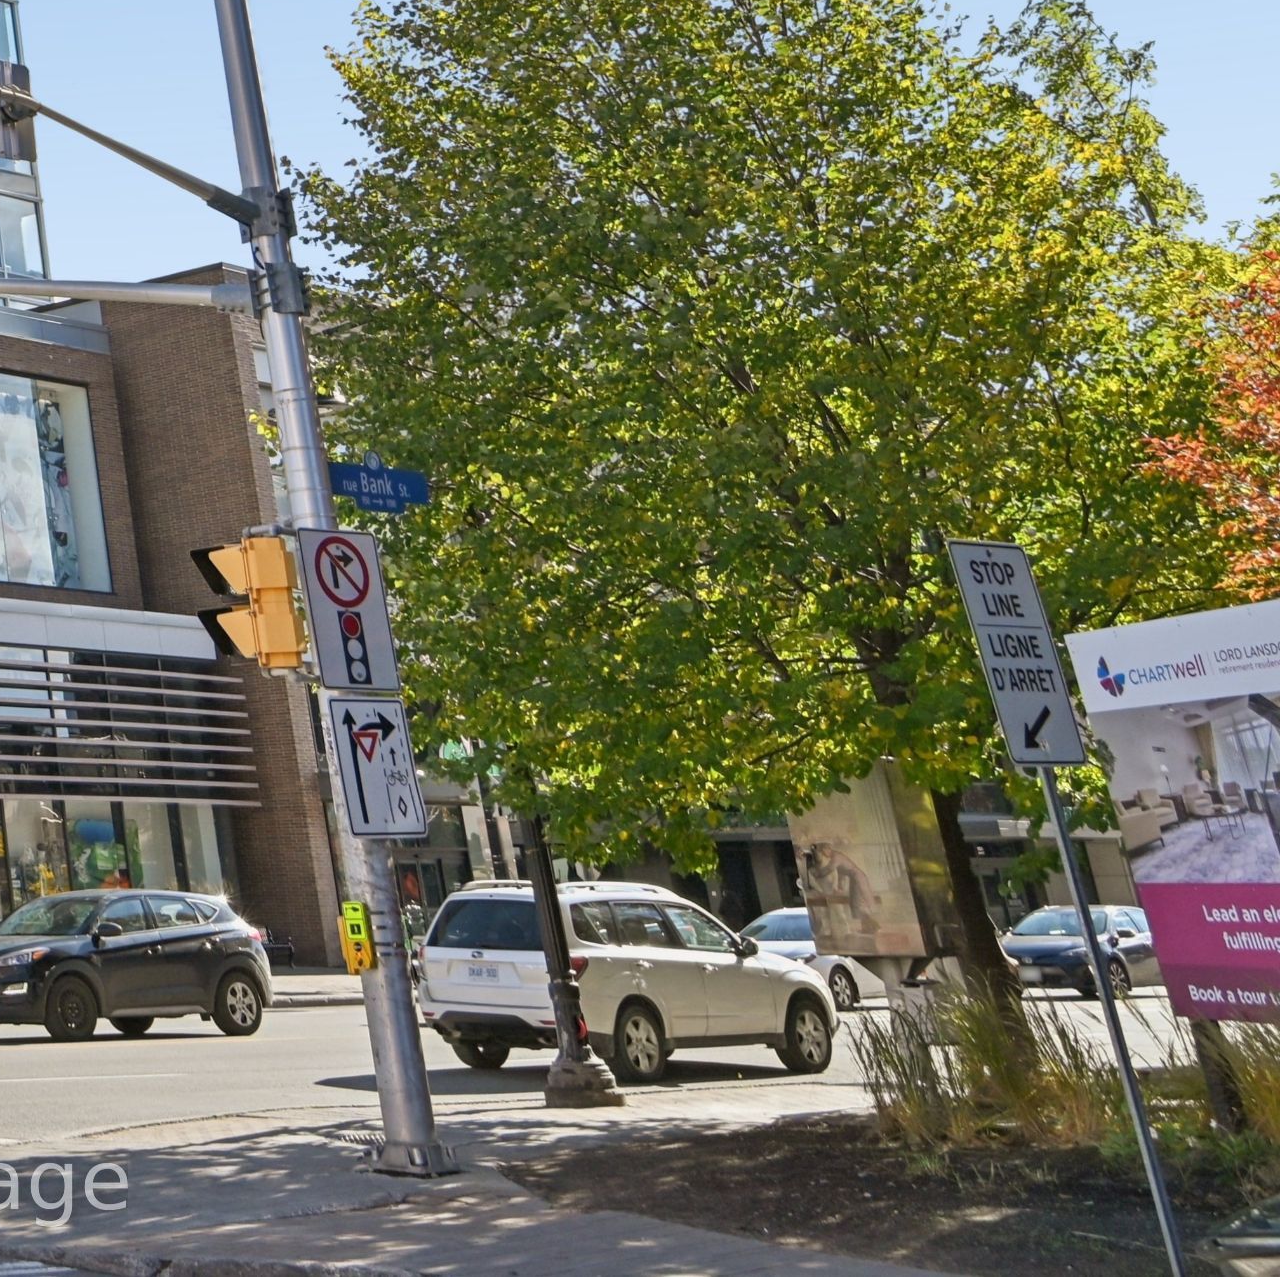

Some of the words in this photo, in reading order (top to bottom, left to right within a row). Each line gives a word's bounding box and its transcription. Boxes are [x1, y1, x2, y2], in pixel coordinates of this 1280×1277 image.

[342, 479, 358, 492] rue
[360, 472, 394, 496] Bank
[969, 559, 1015, 585] STOP
[982, 593, 1024, 617] LINE
[988, 633, 1043, 659] LIGNE
[1213, 647, 1242, 662] LORD
[1243, 641, 1280, 658] LANSD
[992, 665, 1057, 693] D'ARRÊT
[1202, 904, 1239, 922] Lead
[1241, 908, 1261, 923] an
[1187, 984, 1225, 1003] Book
[1226, 990, 1237, 1003] a
[1237, 987, 1267, 1005] tour
